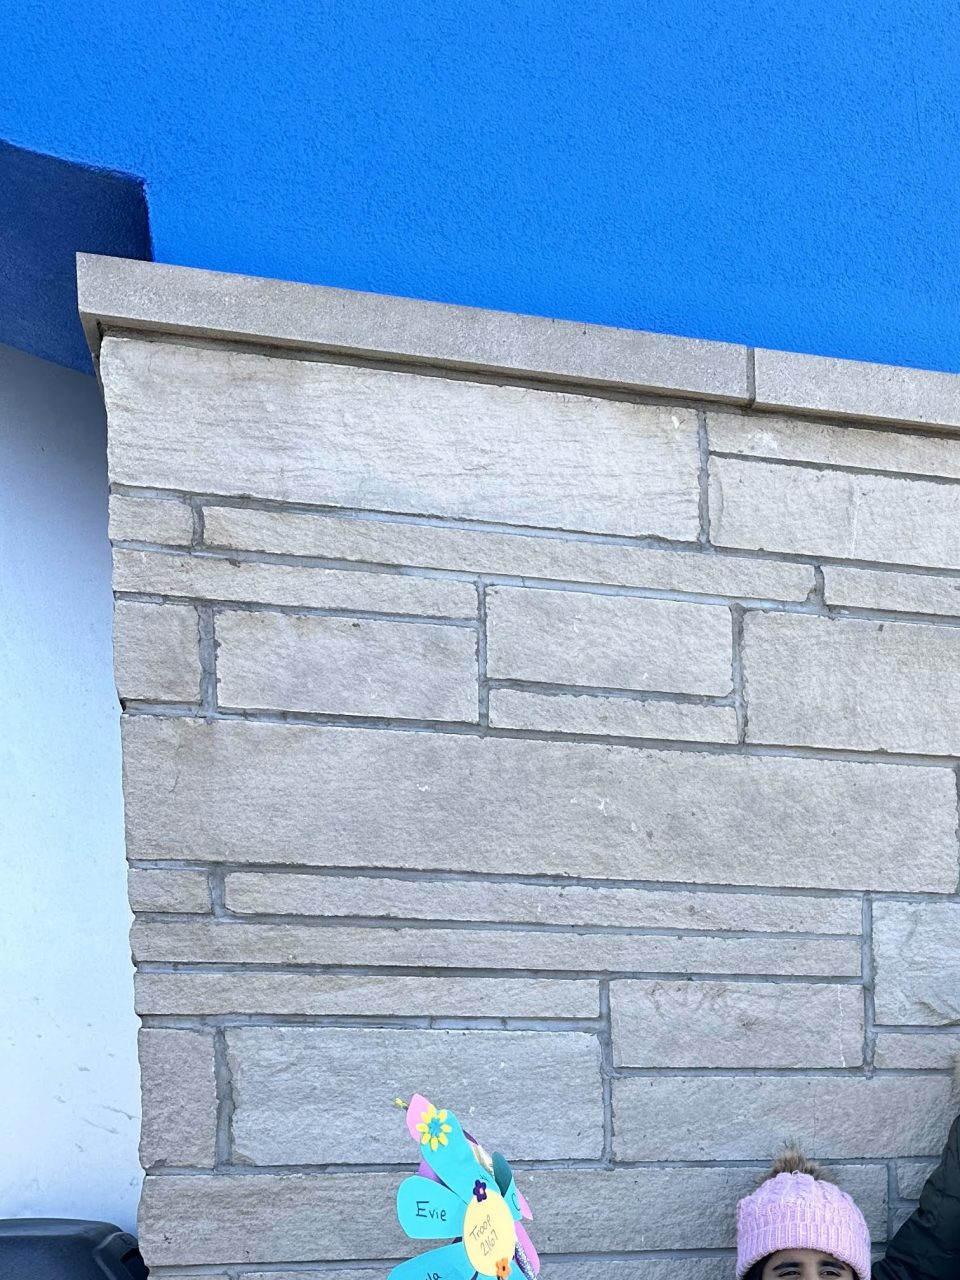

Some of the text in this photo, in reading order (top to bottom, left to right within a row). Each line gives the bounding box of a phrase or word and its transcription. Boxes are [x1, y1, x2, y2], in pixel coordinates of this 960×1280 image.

[415, 1200, 447, 1221] Evie
[469, 1215, 492, 1241] Troop
[480, 1229, 498, 1256] 2167
